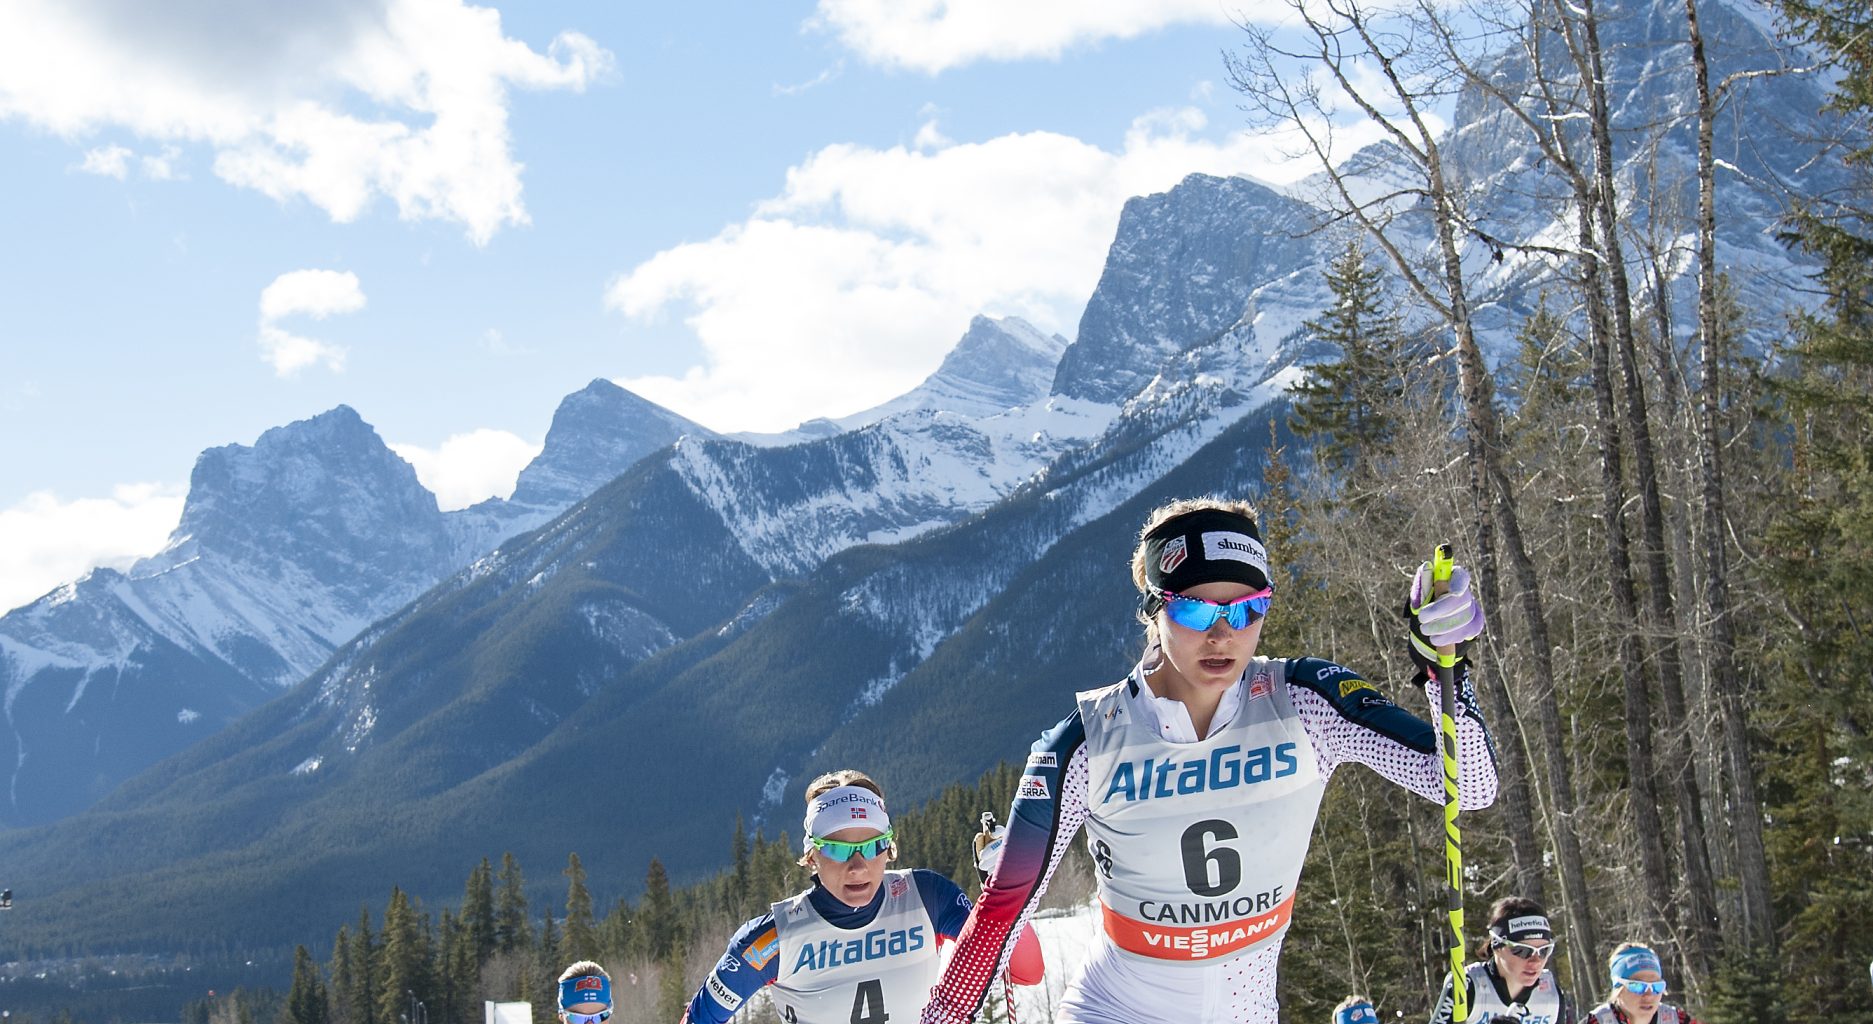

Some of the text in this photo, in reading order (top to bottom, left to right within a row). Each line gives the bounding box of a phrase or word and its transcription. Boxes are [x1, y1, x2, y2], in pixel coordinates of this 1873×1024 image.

[1102, 742, 1298, 804] AltaGas
[1180, 818, 1243, 898] 6
[1139, 884, 1284, 924] CANMORE
[1511, 919, 1543, 929] helvetia
[792, 925, 925, 975] AltaGas
[1142, 914, 1278, 958] VIESSMANN
